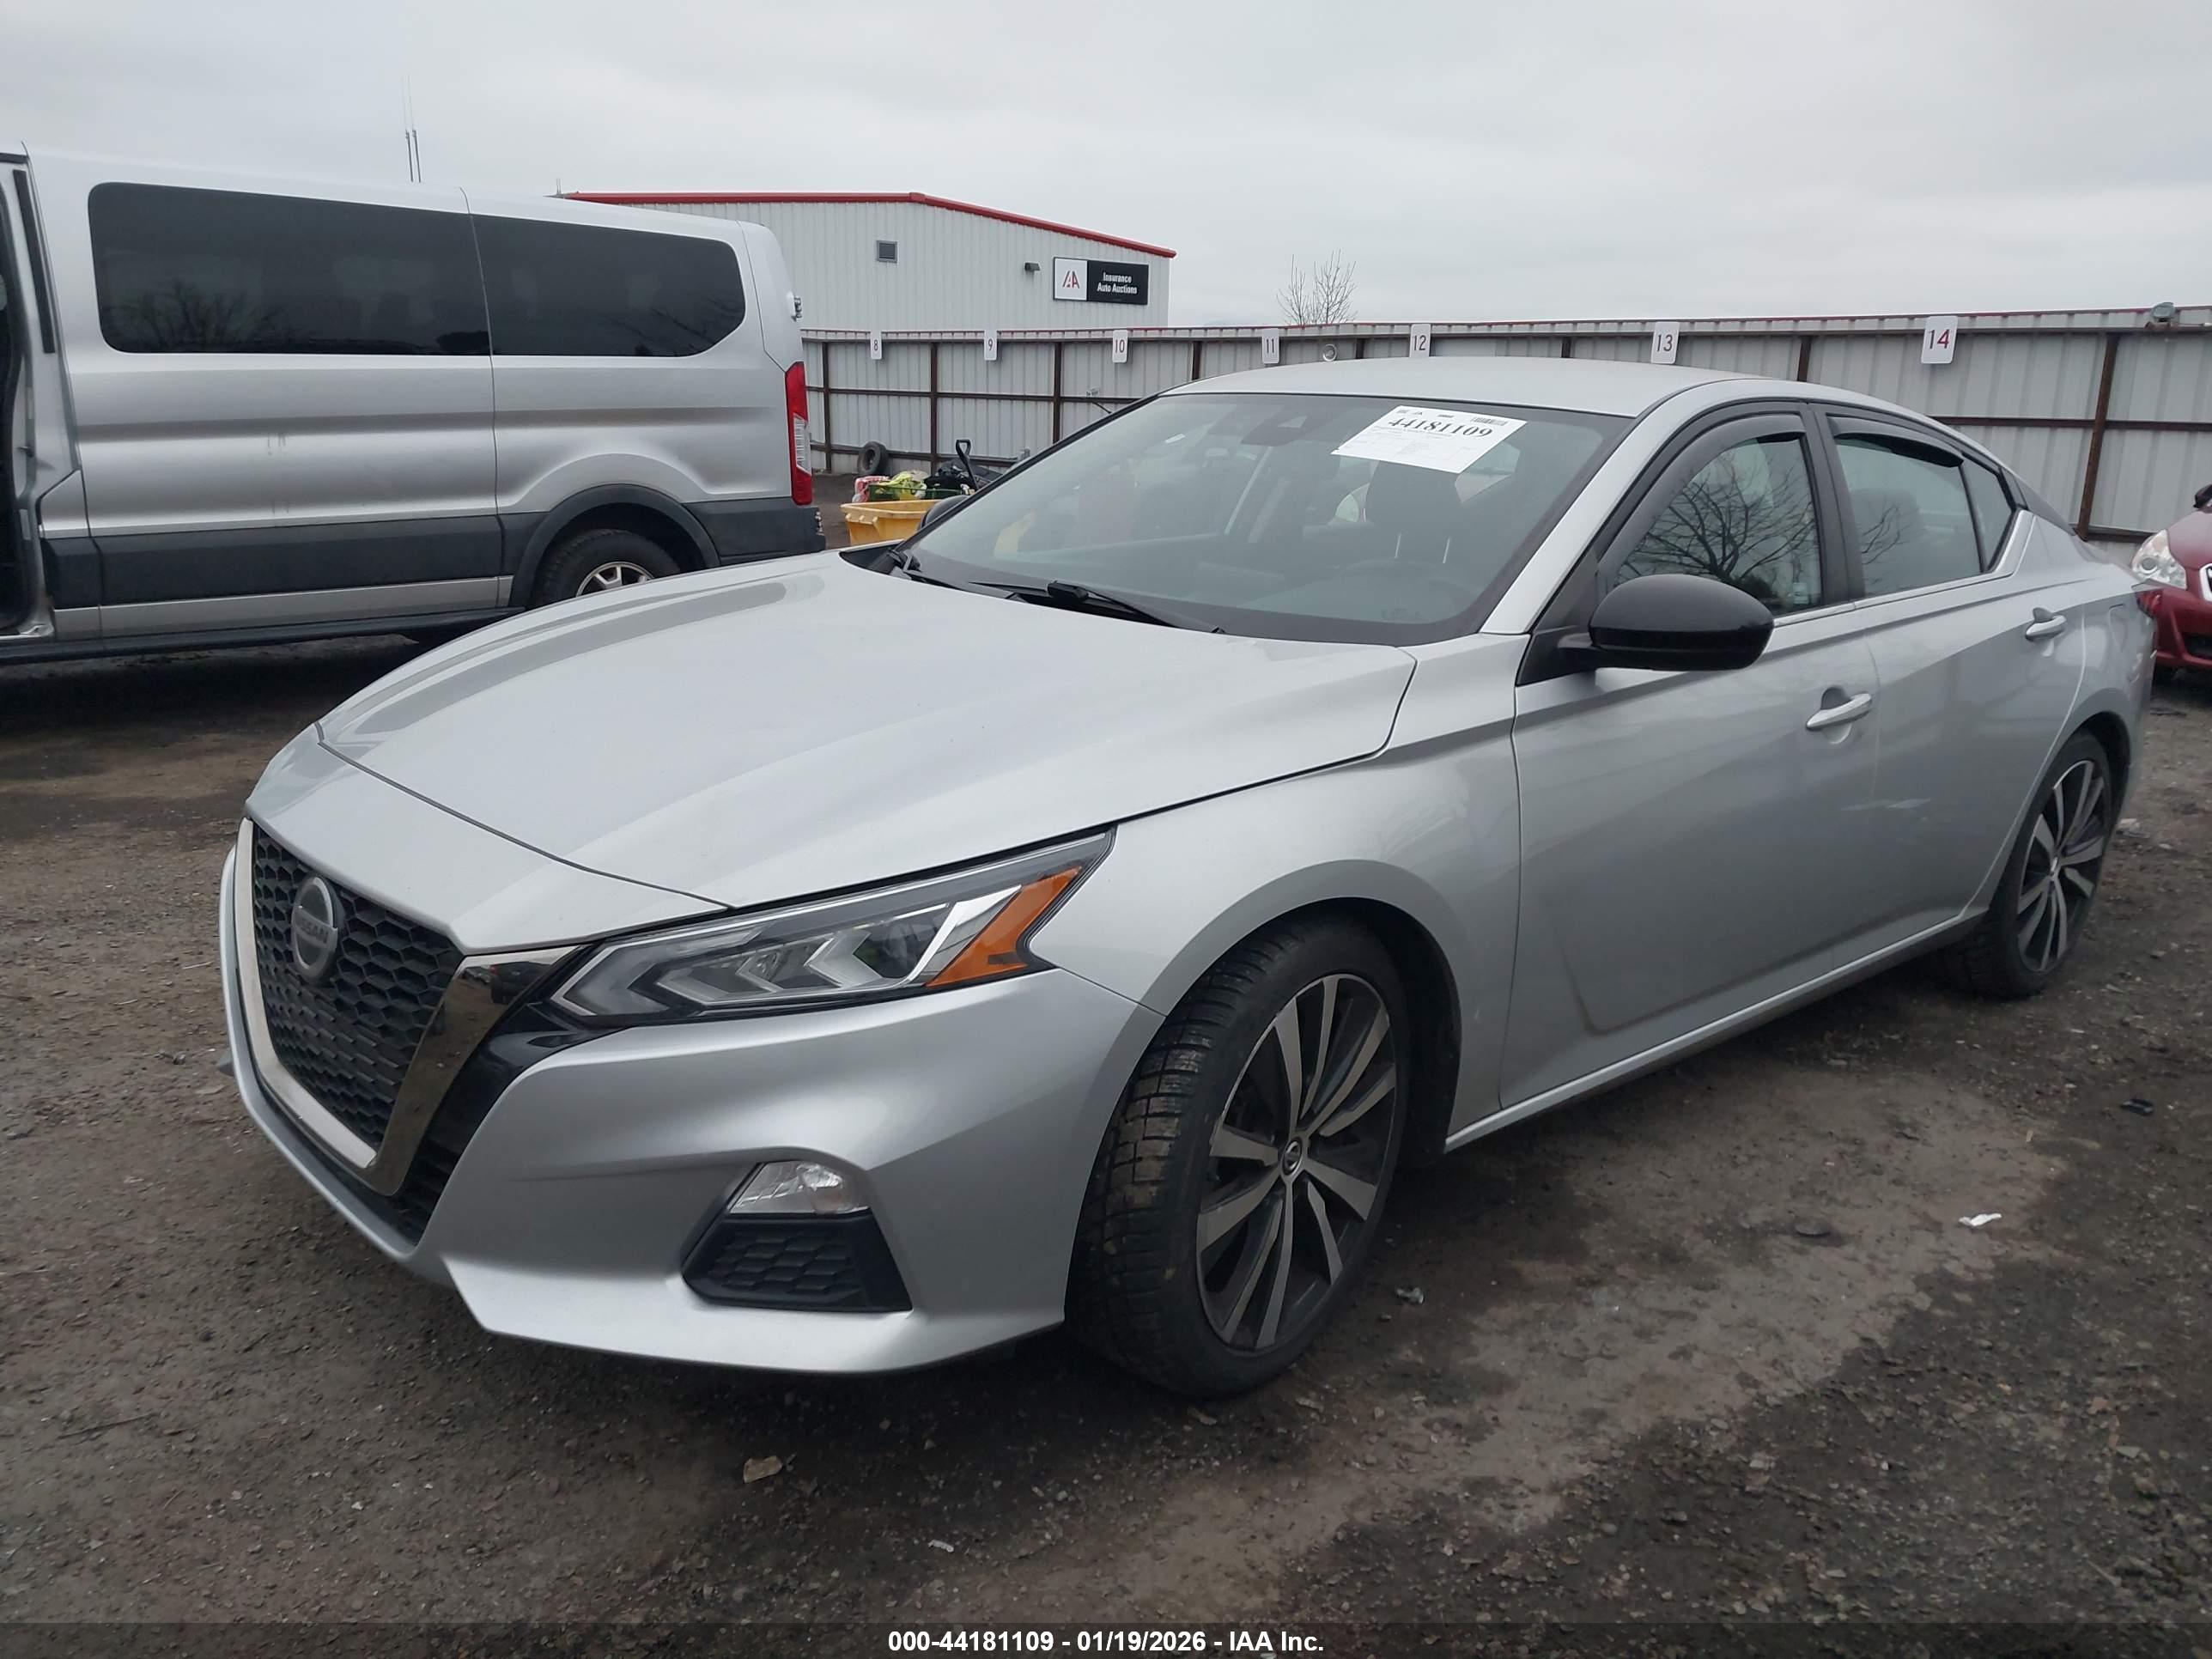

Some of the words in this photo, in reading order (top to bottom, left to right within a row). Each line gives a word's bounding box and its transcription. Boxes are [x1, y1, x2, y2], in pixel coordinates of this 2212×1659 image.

[1103, 271, 1132, 283] Insurance
[1097, 282, 1111, 293] Auto
[1112, 283, 1138, 295] Auctions
[873, 339, 878, 351] 8
[988, 338, 993, 351] 9
[1115, 339, 1125, 354] 10
[1266, 338, 1275, 353] 11
[1413, 335, 1426, 350] 12
[1657, 334, 1673, 351] 13
[1928, 329, 1949, 349] 14
[1389, 417, 1492, 438] 44181109
